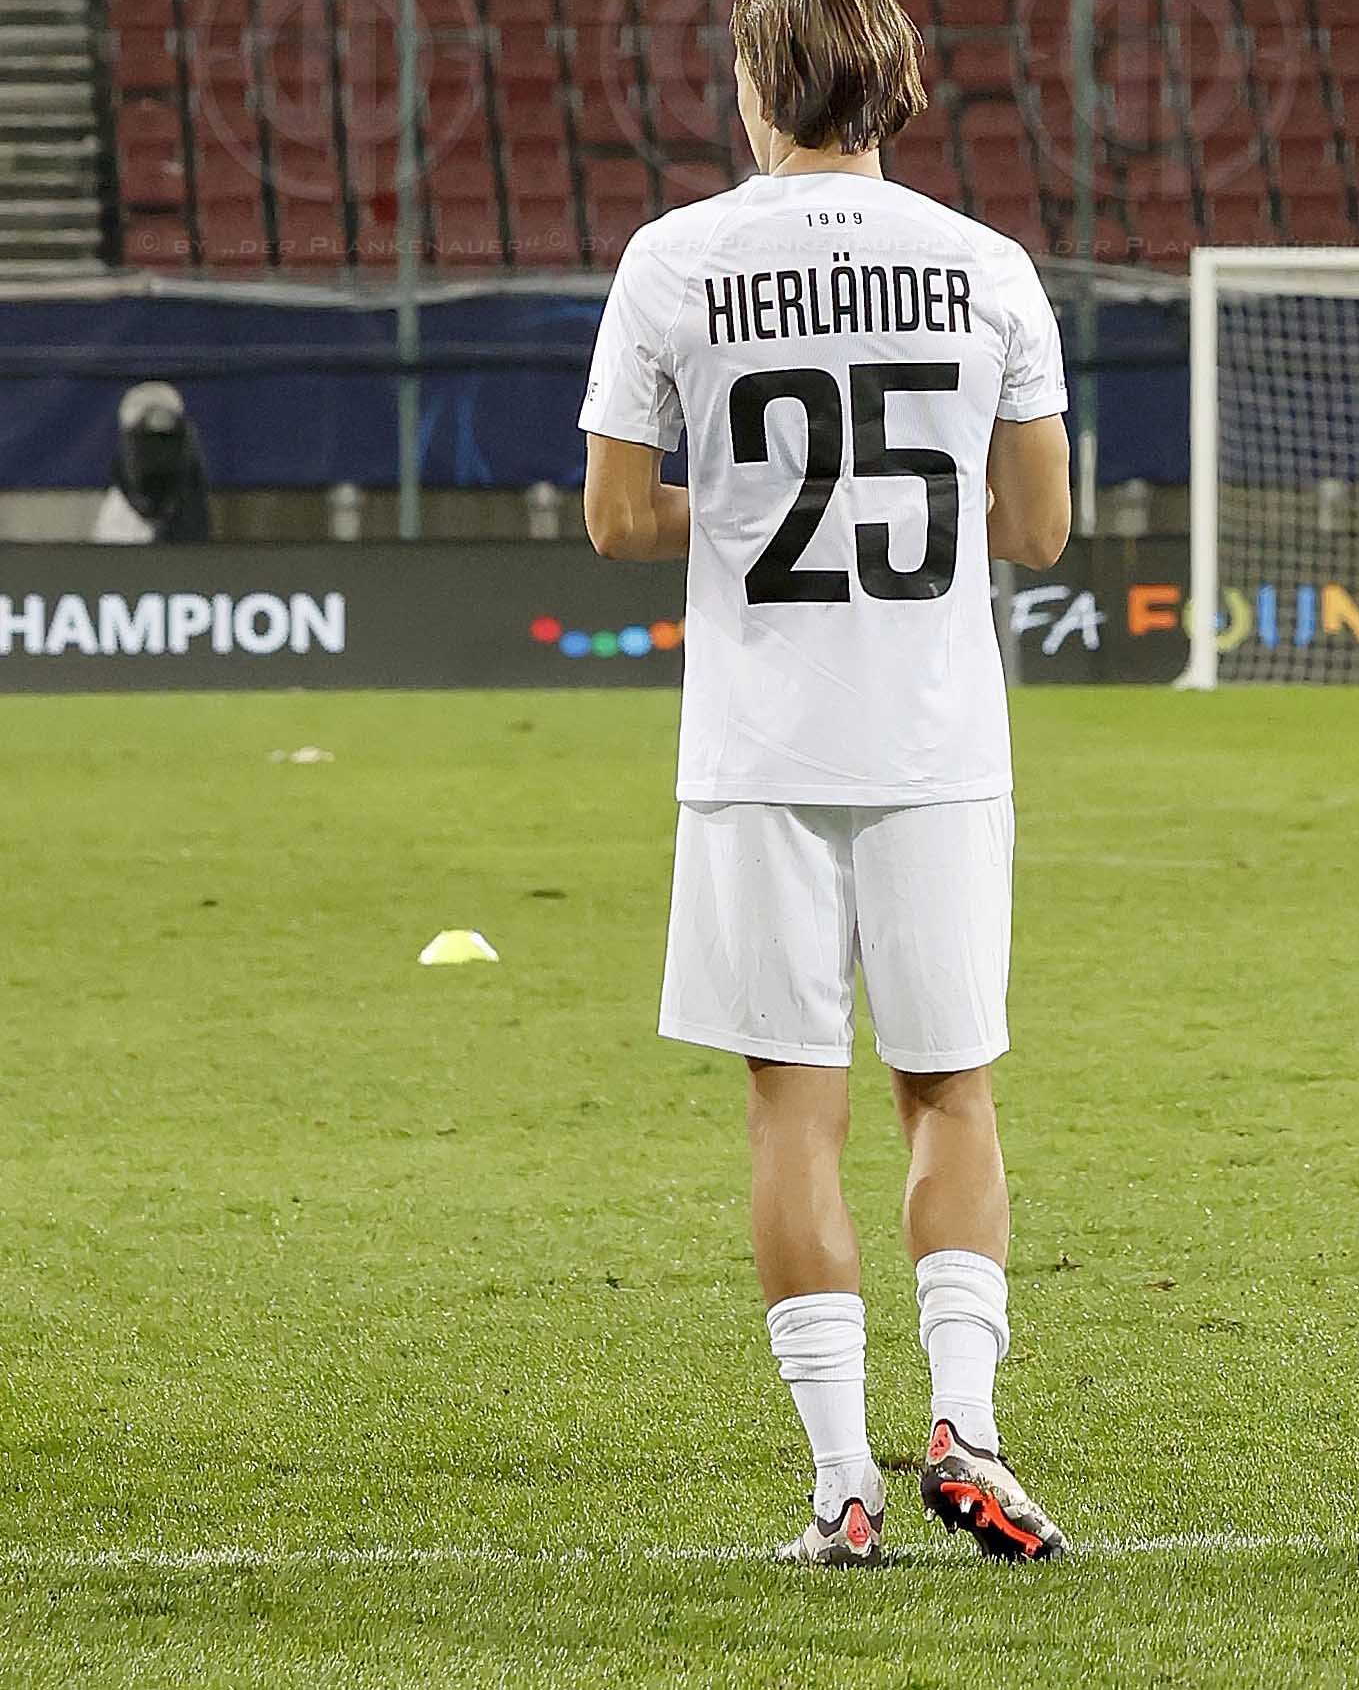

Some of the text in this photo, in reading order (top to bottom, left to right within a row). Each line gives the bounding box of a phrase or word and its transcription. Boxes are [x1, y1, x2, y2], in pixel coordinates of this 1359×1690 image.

[805, 212, 863, 228] 1909
[704, 251, 972, 346] HIERLÄNDER
[728, 362, 960, 605] 25
